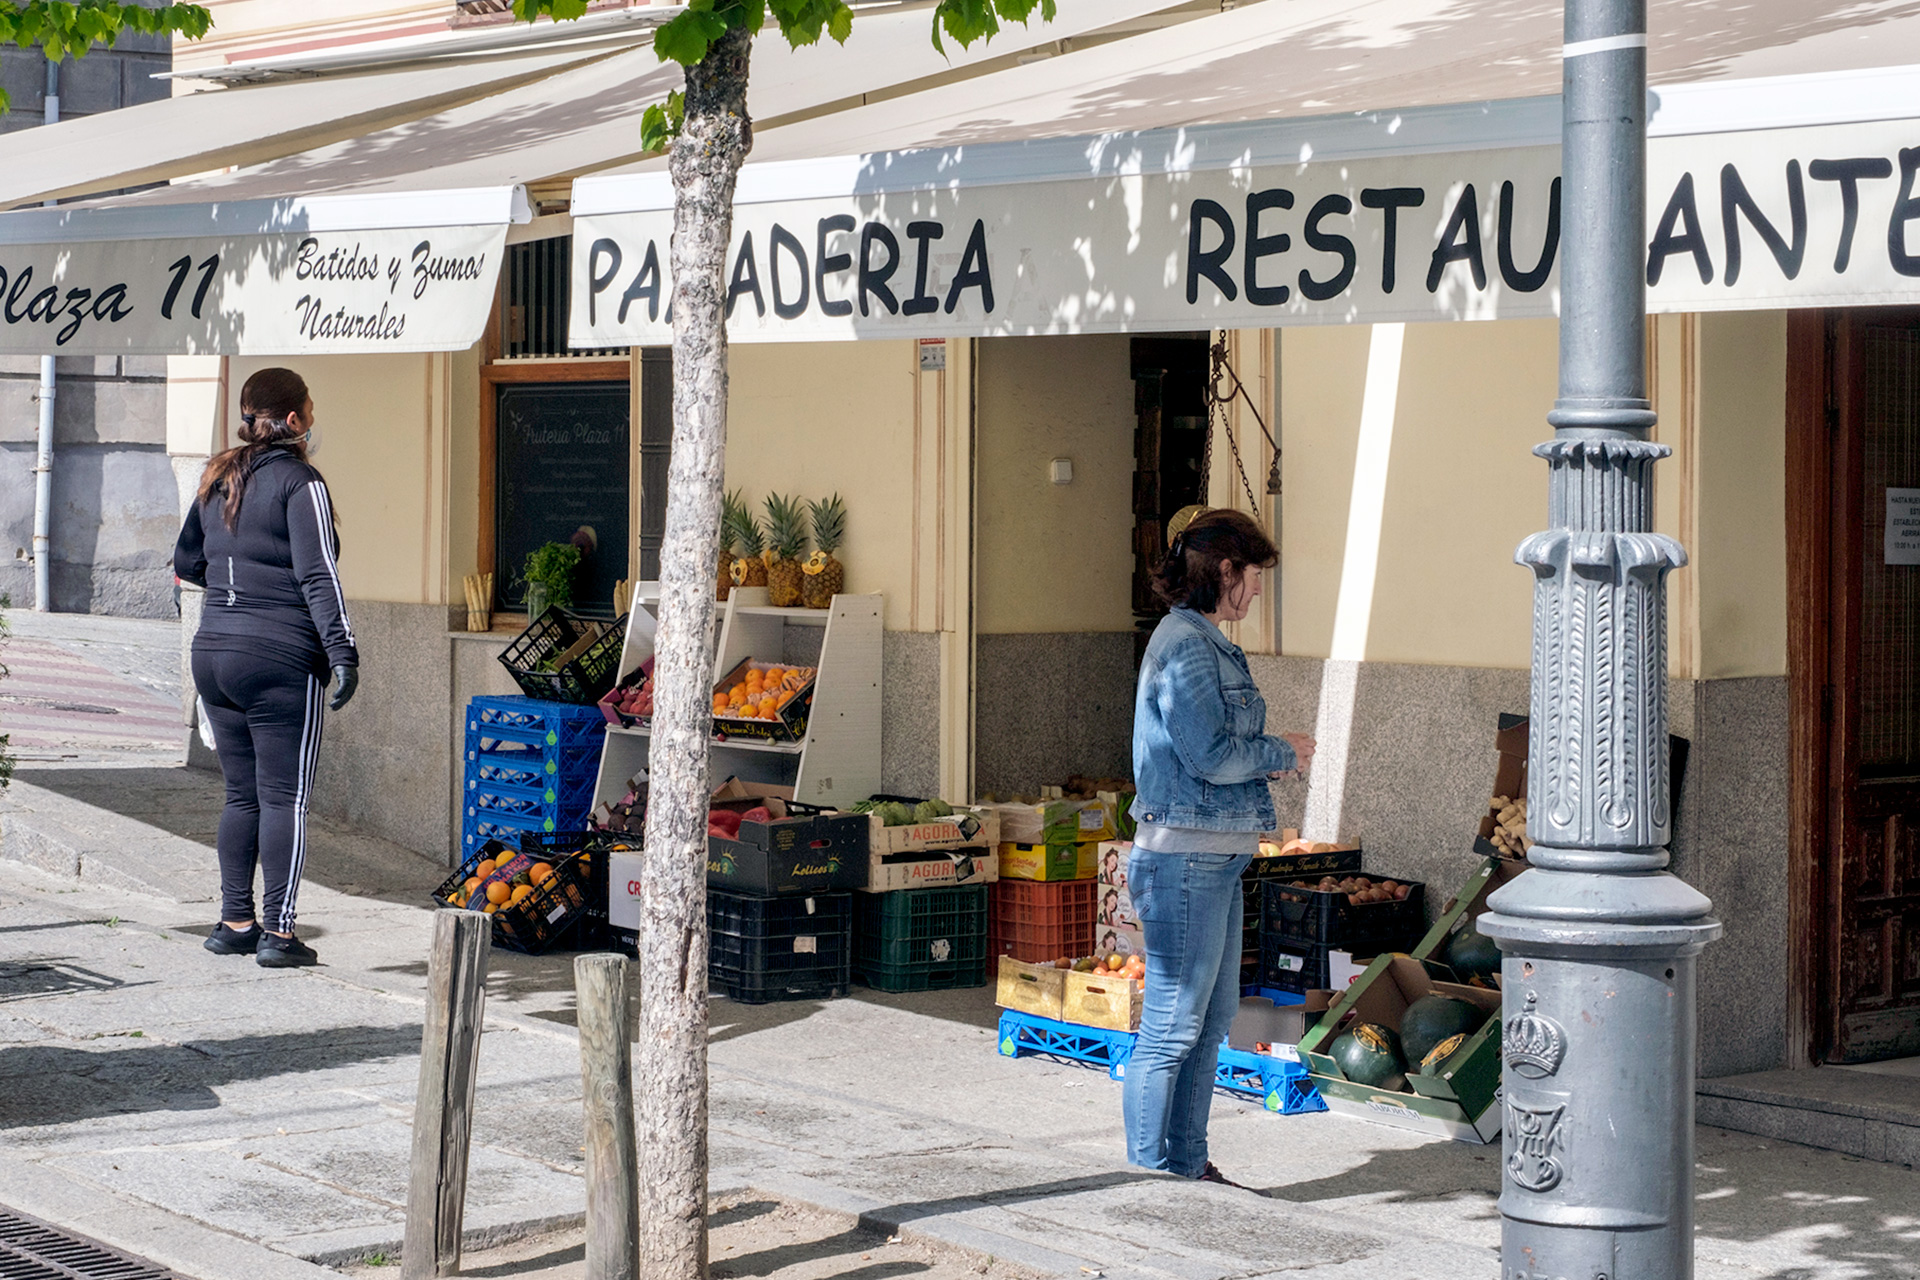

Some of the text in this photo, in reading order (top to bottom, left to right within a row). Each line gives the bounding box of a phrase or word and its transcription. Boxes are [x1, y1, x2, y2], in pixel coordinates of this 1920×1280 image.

[1187, 145, 1920, 305] RESTAUANTE
[161, 253, 220, 320] 11
[296, 237, 485, 296] Batidos y Zumos
[590, 214, 995, 326] PAADERIA
[296, 294, 406, 341] Naturales
[573, 421, 610, 444] Plaza
[614, 423, 625, 443] 11
